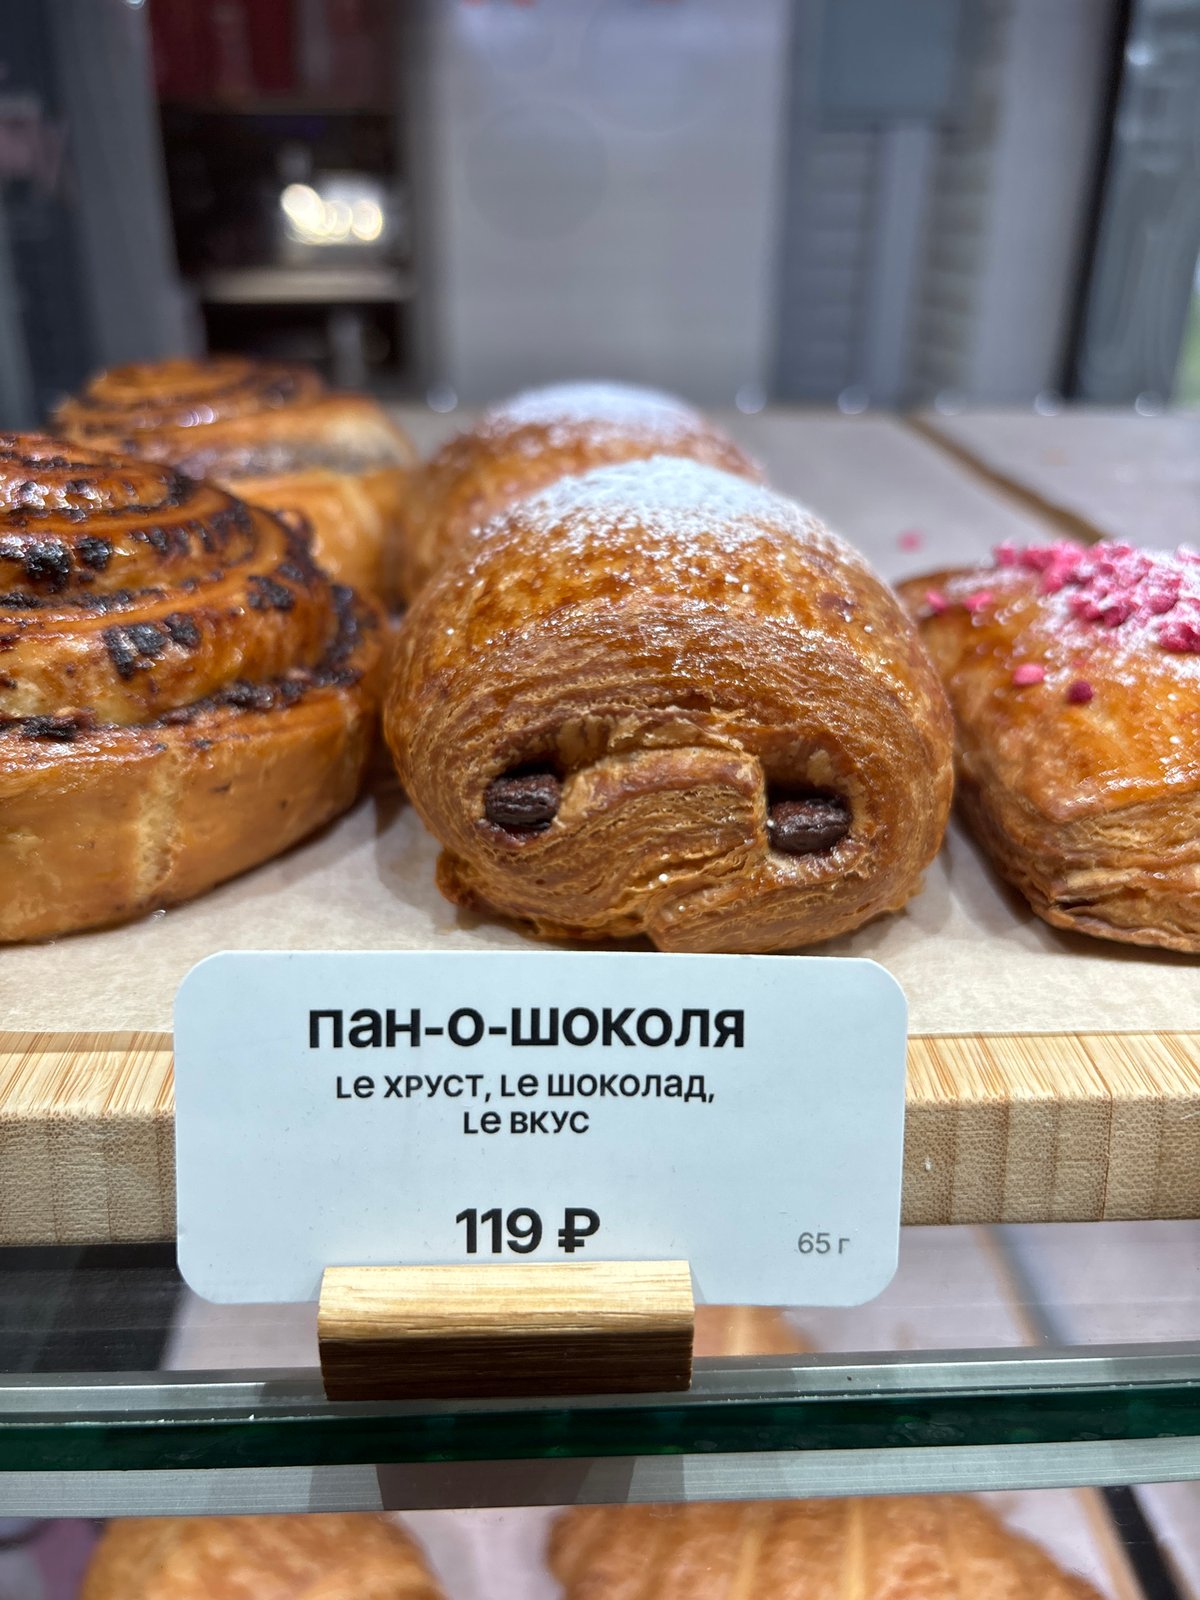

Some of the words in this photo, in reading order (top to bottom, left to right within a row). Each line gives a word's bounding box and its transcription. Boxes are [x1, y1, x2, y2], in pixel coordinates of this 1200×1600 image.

[309, 1006, 746, 1049] пан-о-шоколя
[547, 1073, 715, 1104] шоколад,
[455, 1207, 543, 1255] 119
[557, 1207, 601, 1254] ₽
[797, 1232, 831, 1254] 65
[838, 1236, 850, 1254] г
